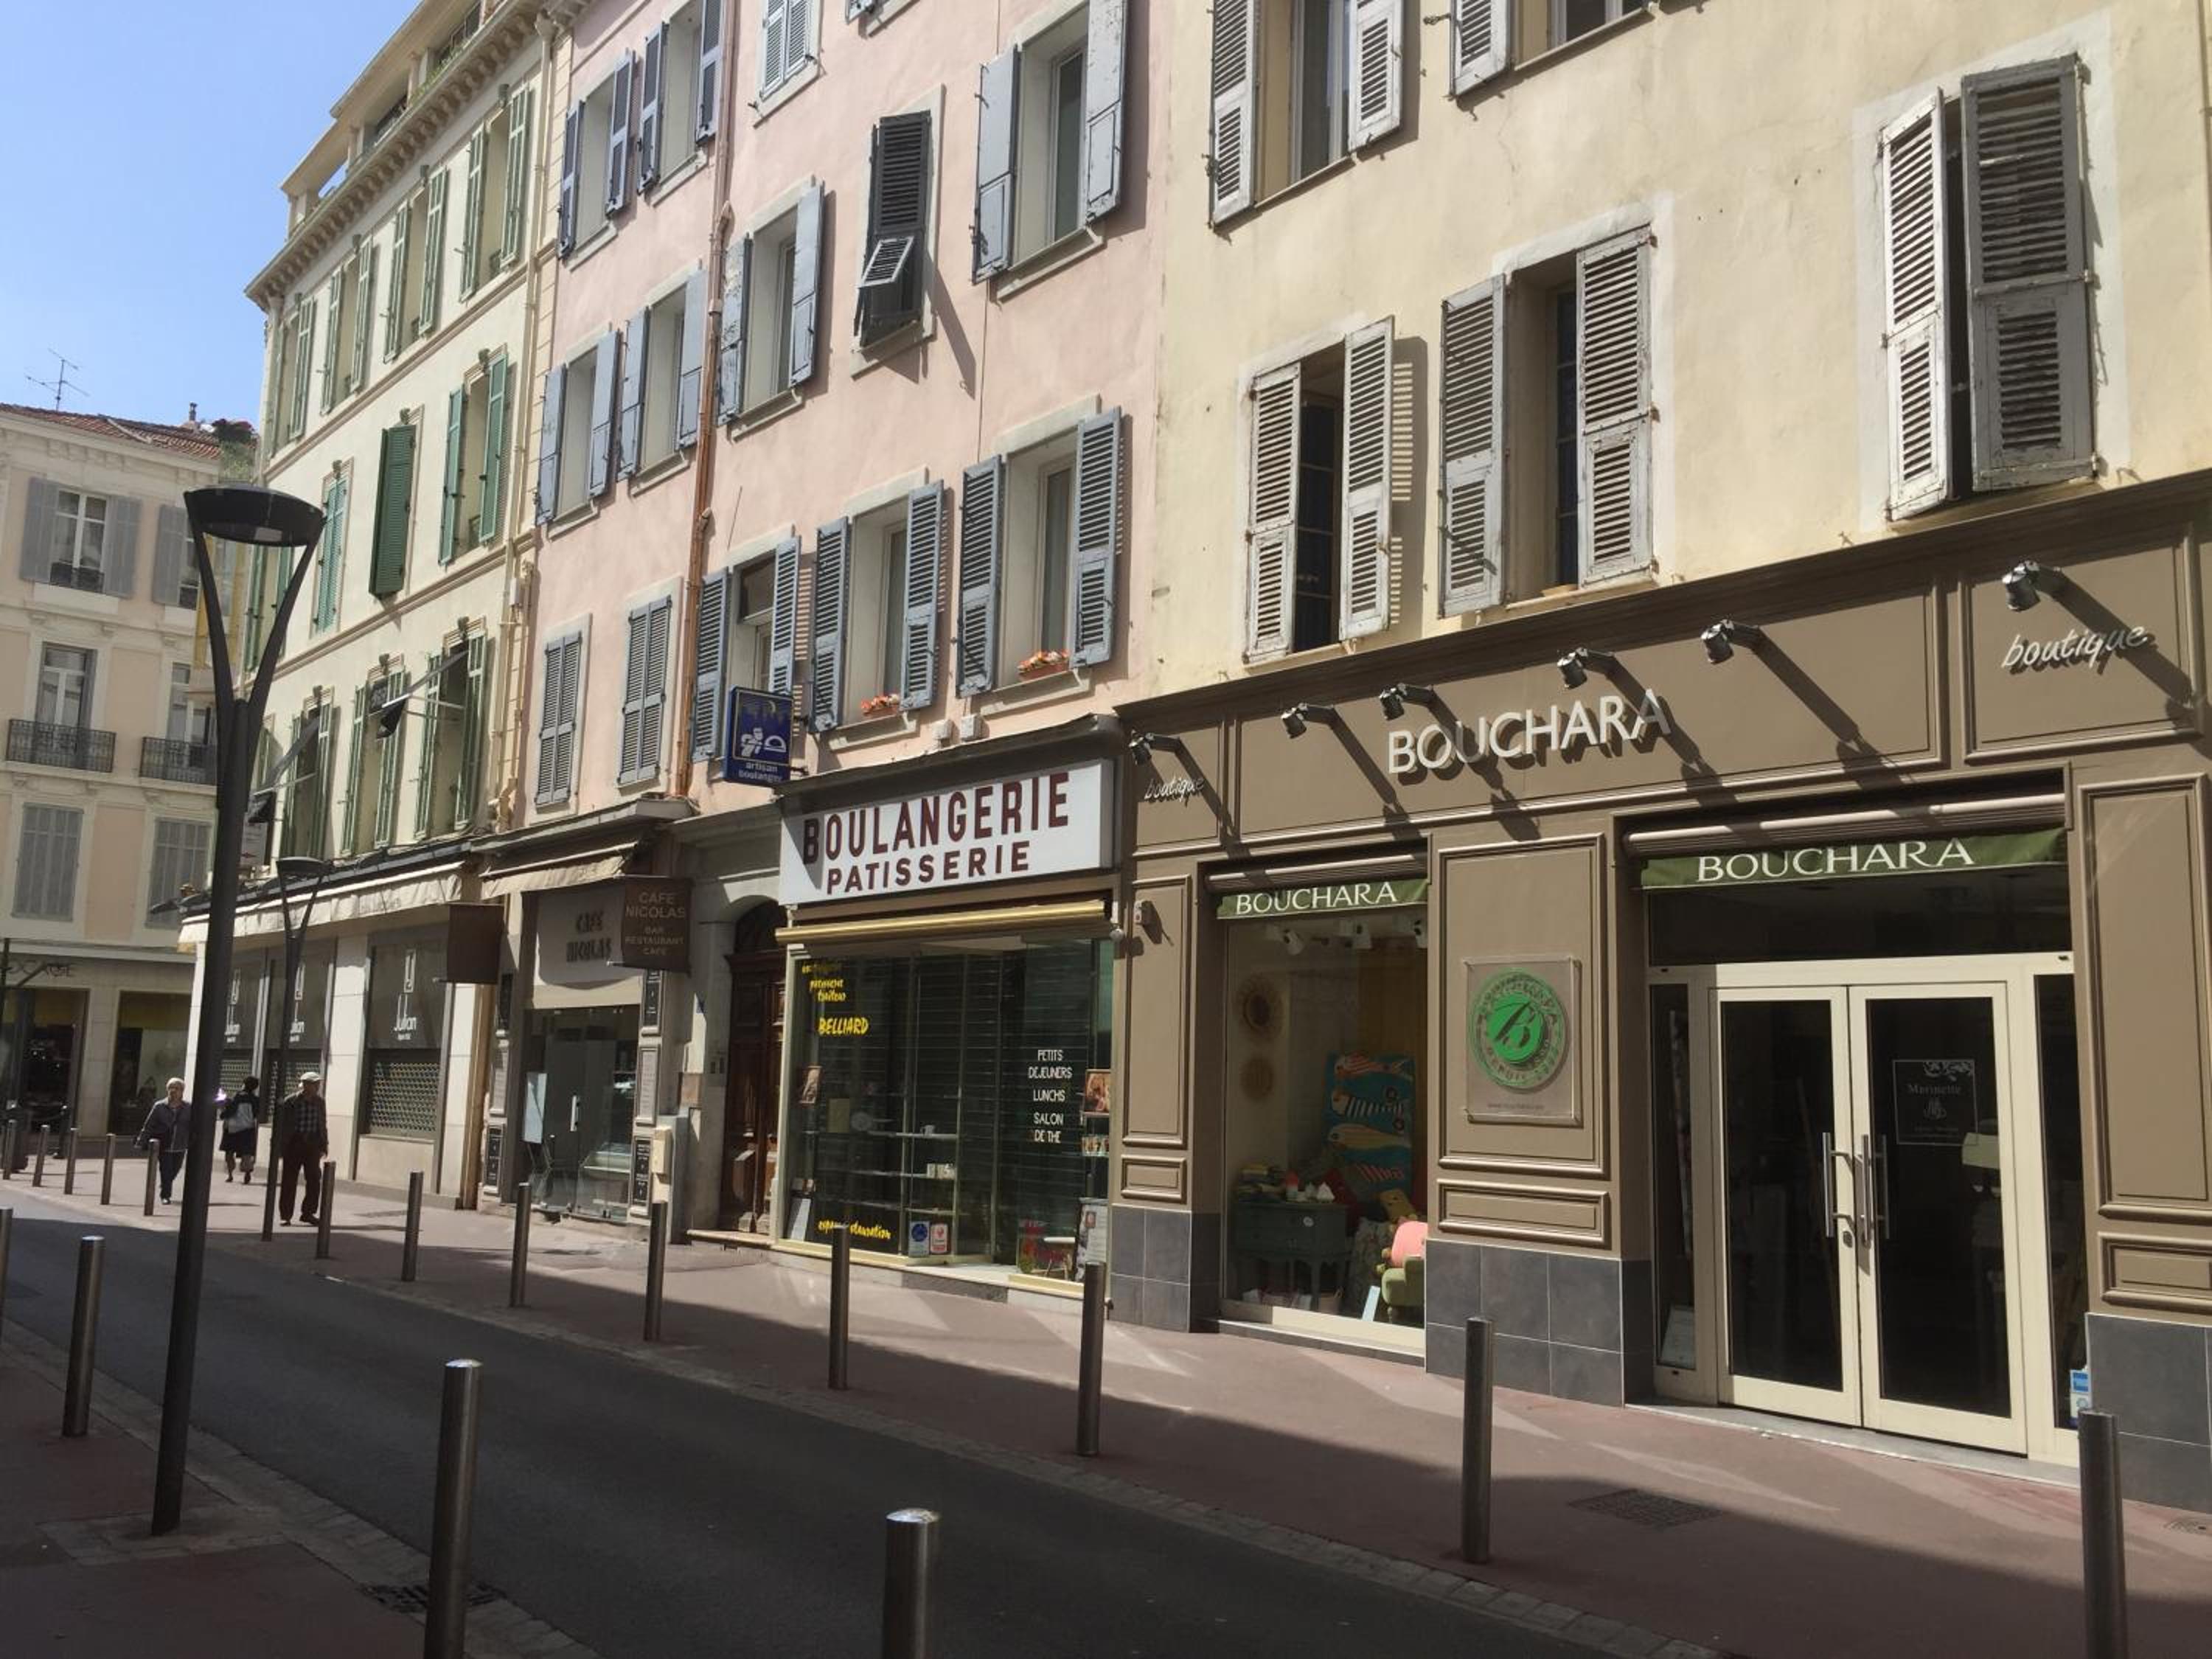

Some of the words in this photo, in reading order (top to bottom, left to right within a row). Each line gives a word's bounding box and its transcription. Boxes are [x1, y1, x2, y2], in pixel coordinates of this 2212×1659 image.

[2001, 624, 2149, 669] boutique
[1388, 688, 1671, 774] BOUCHARA
[1144, 775, 1205, 802] boutique
[803, 771, 1070, 866] BOULANGERIE
[827, 841, 1030, 895] PATISSERIE
[1697, 837, 1975, 883] BOUCHARA
[625, 905, 686, 919] NICOLAS
[1235, 881, 1398, 916] BOUCHARA
[818, 1018, 869, 1034] BELLIARD
[1037, 1049, 1064, 1062] PETITS
[1033, 1089, 1066, 1102] LUNCHS
[1034, 1112, 1064, 1126] SALON
[1034, 1130, 1045, 1143] DE
[1047, 1130, 1062, 1144] THE
